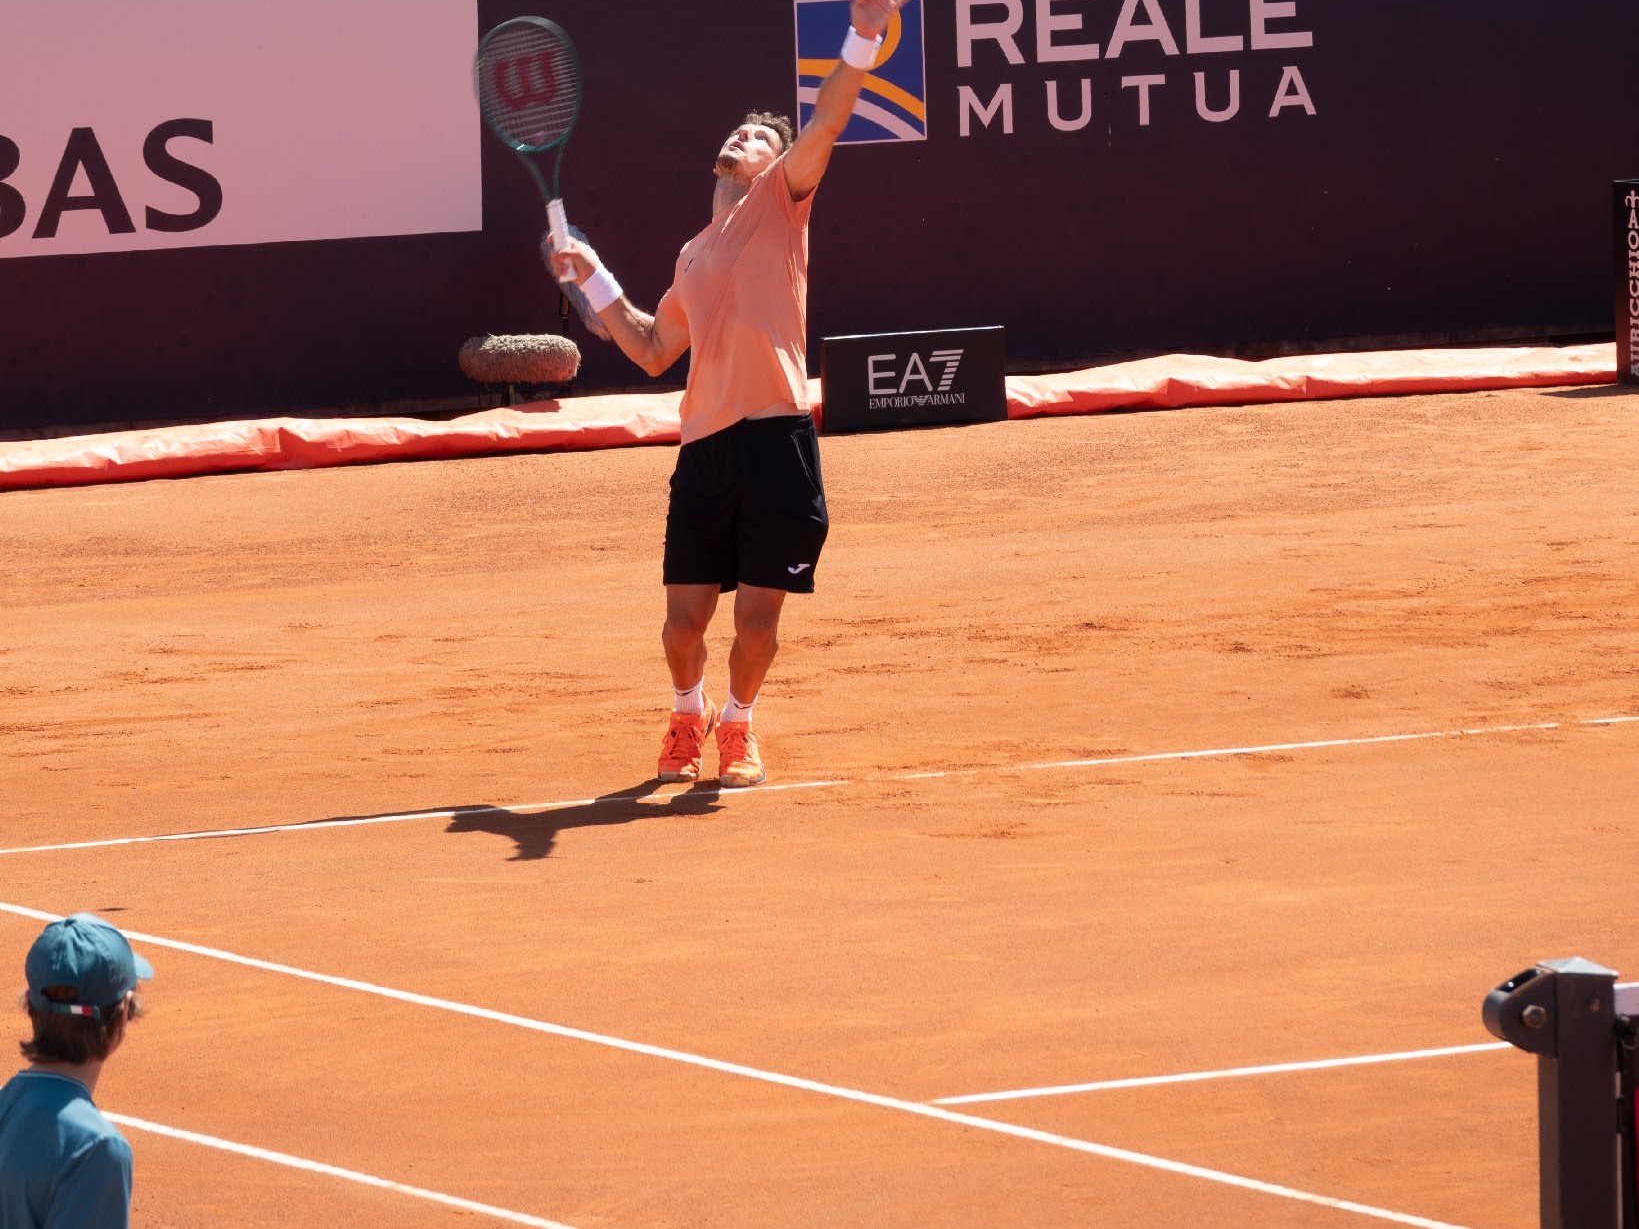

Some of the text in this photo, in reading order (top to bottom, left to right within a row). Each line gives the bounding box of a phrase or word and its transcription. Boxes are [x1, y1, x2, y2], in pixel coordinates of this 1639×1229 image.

[956, 66, 1317, 138] MUTUA
[867, 349, 964, 395] EA7
[869, 392, 965, 409] EMPORIO ARMANI
